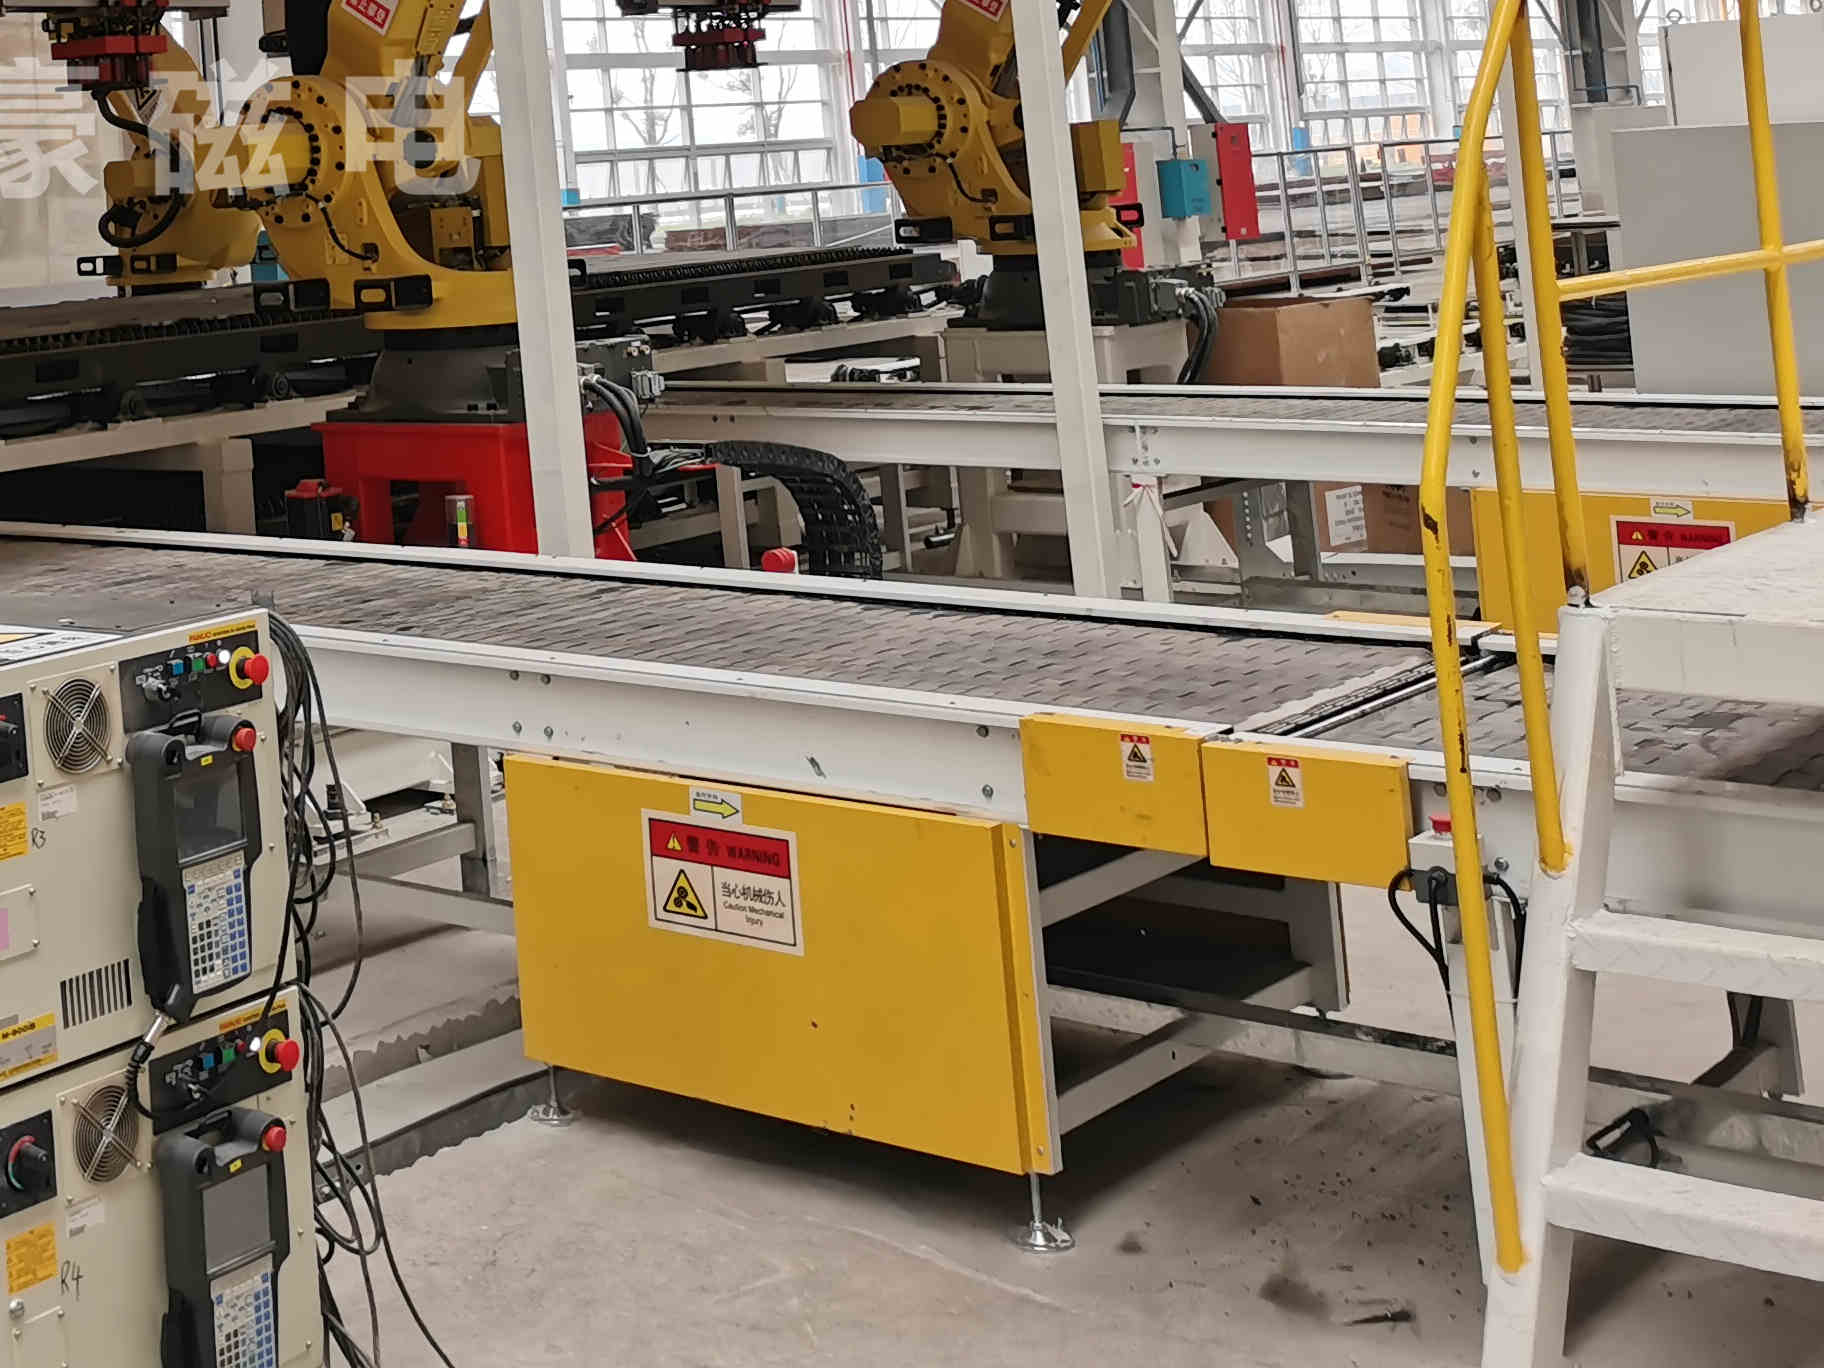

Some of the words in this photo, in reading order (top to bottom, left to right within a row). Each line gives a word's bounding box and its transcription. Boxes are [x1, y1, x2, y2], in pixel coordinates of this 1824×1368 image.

[727, 845, 780, 867] WARNING
[721, 881, 786, 907] 当心机械伤人
[60, 1259, 84, 1303] R4
